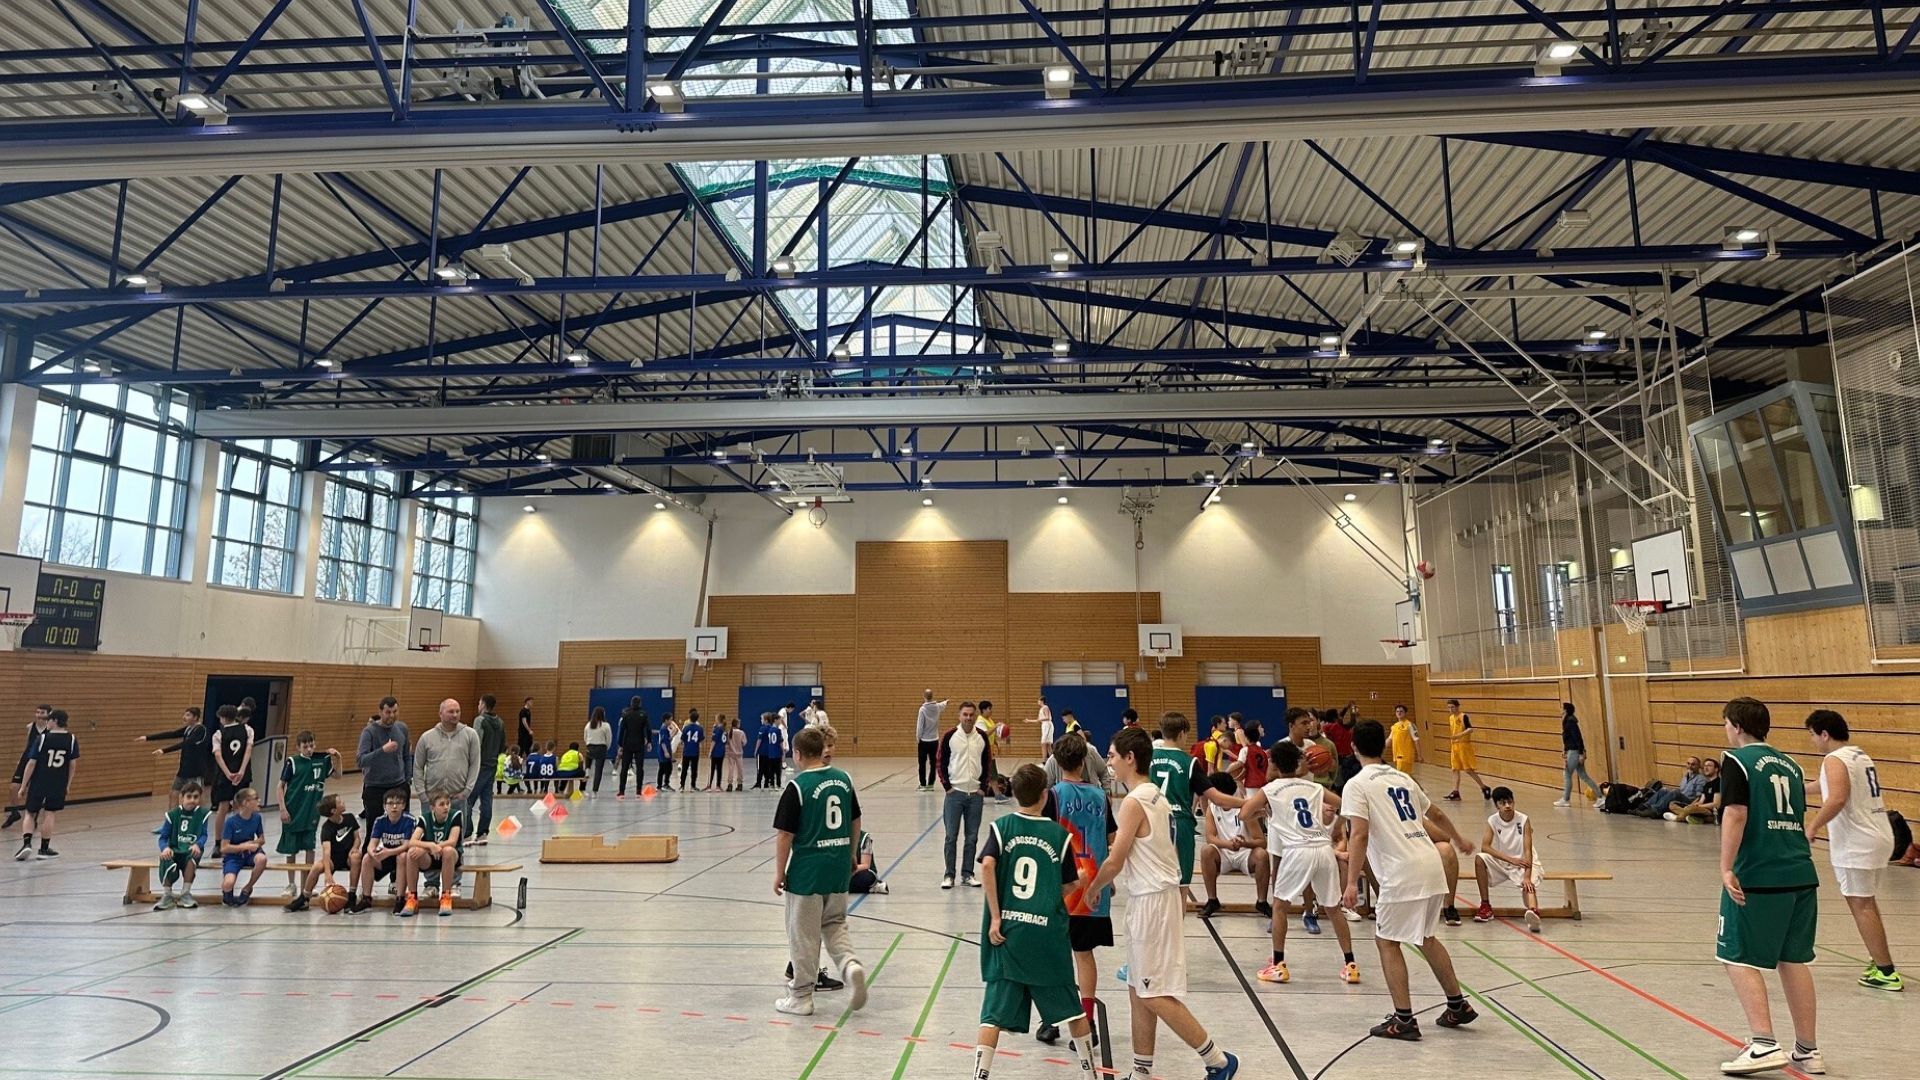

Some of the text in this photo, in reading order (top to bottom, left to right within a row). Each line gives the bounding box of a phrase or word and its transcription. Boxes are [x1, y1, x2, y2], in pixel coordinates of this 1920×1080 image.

[686, 730, 699, 743] 14
[767, 732, 777, 744] 10
[229, 739, 241, 756] 9
[47, 749, 67, 768] 15
[528, 761, 535, 774] 7
[540, 763, 554, 776] 88
[1156, 770, 1170, 797] 7
[1769, 773, 1794, 814] 11
[826, 794, 843, 830] 6
[1293, 797, 1314, 828] 8
[1387, 787, 1417, 822] 13
[180, 819, 189, 832] 8
[433, 831, 445, 844] 12
[1075, 826, 1092, 858] 1
[1004, 836, 1060, 864] DON BOSCO SCHULE
[1012, 856, 1038, 900] 9
[1001, 909, 1049, 927] TAPPENBACH
